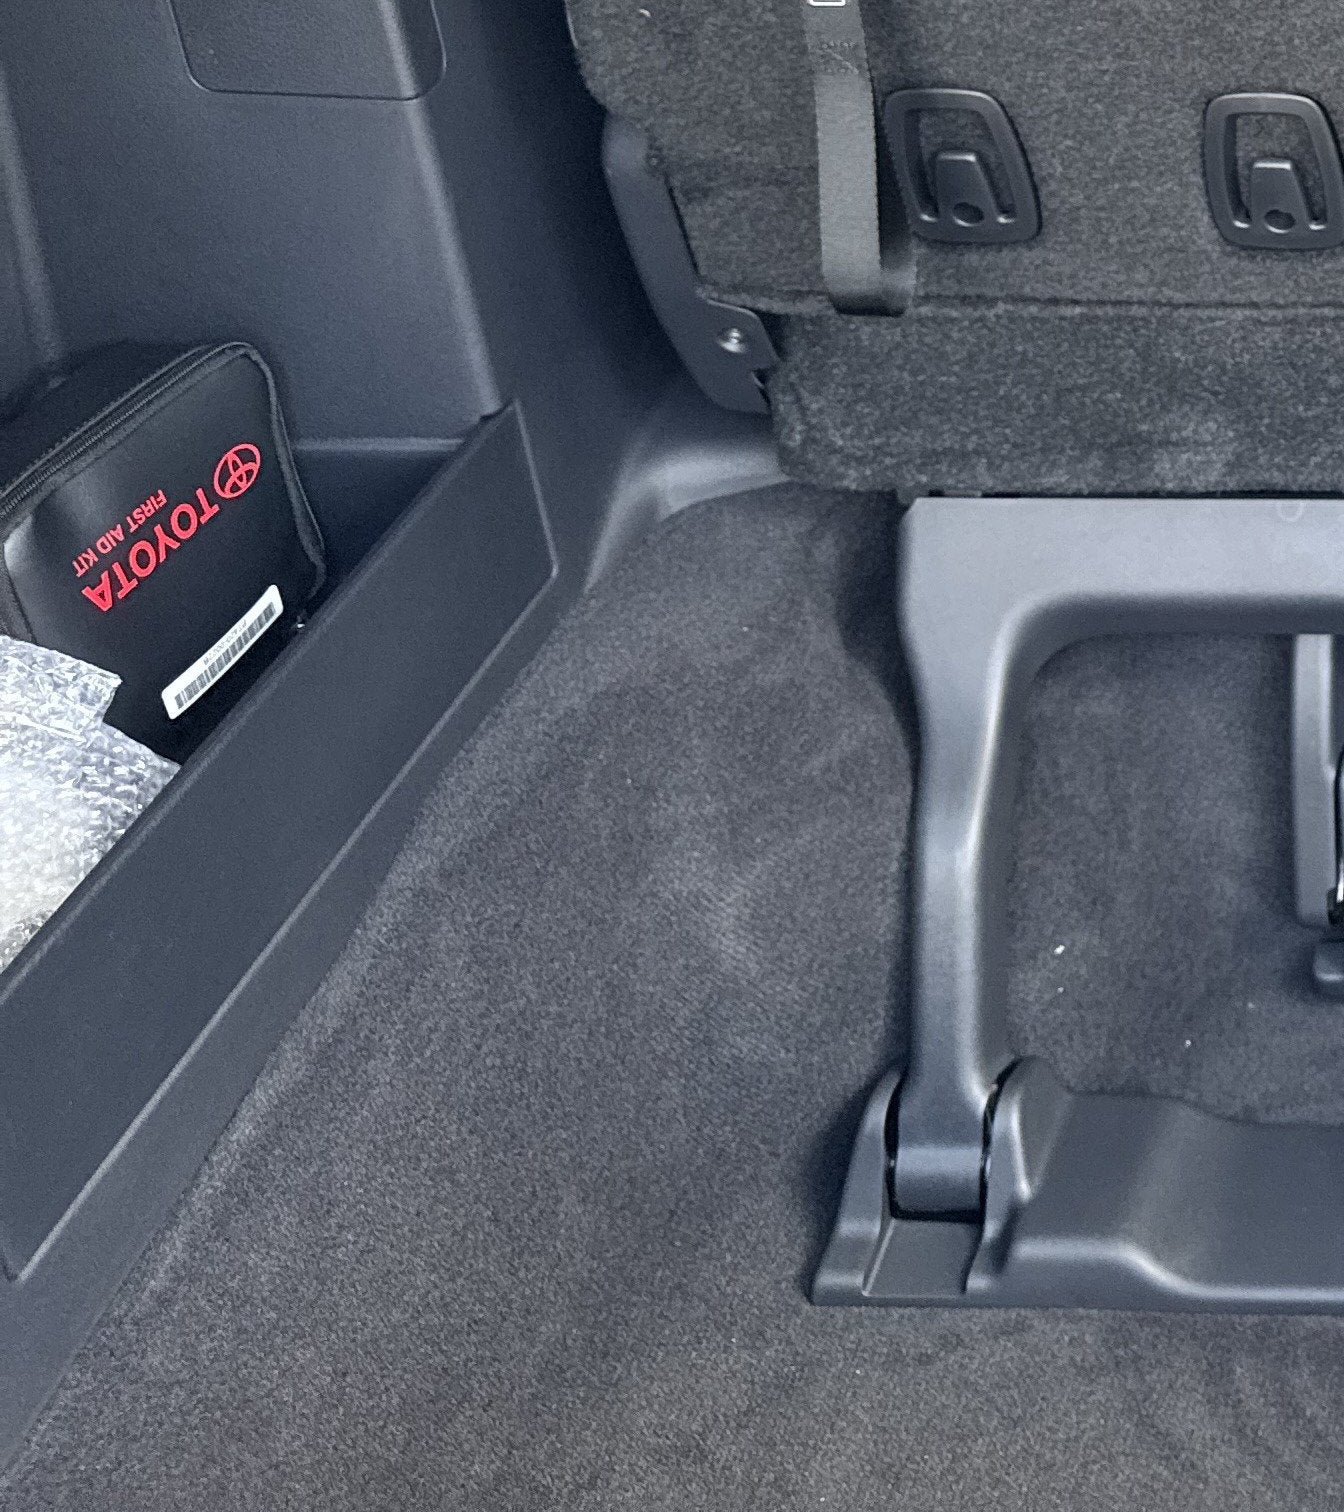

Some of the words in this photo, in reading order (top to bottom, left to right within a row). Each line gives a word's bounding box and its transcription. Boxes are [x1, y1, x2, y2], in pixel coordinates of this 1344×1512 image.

[126, 489, 168, 533] FIRST
[81, 487, 221, 612] TOYOTA
[95, 523, 126, 554] AID
[71, 548, 99, 578] KIT
